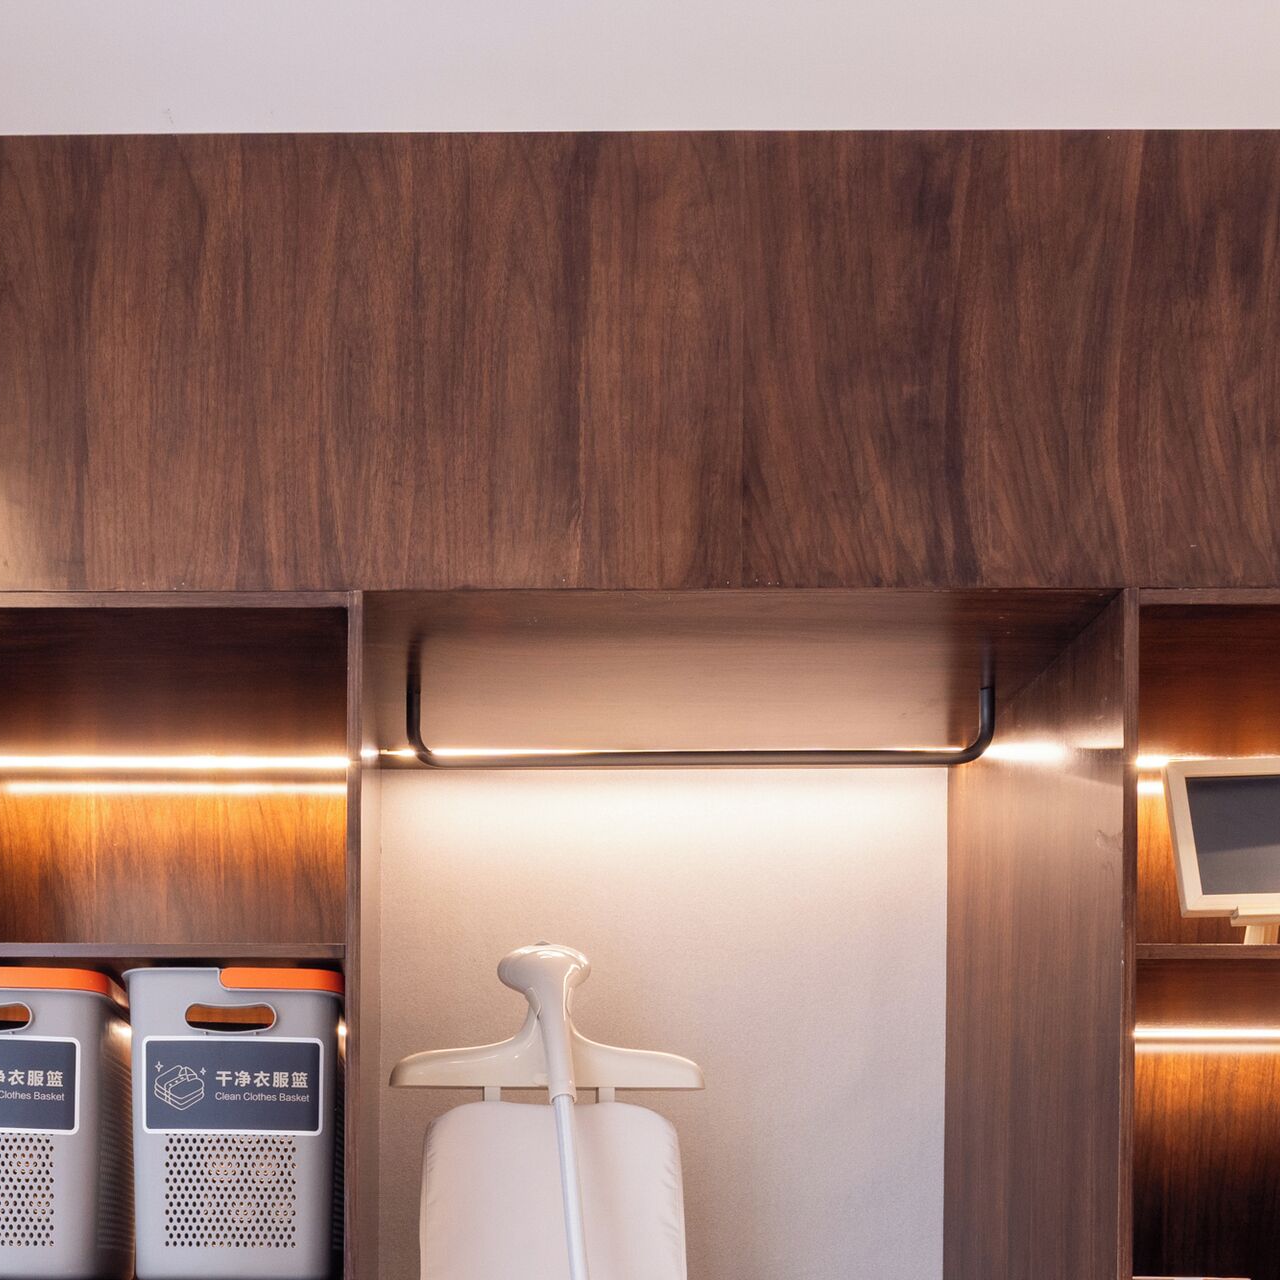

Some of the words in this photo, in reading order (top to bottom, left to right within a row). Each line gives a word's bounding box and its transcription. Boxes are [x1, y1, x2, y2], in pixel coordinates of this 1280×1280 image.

[215, 1070, 309, 1089] 干净衣服篮
[33, 1092, 65, 1101] Basket
[215, 1092, 241, 1101] Clean
[243, 1092, 277, 1102] Clothes
[279, 1093, 310, 1103] Basket
